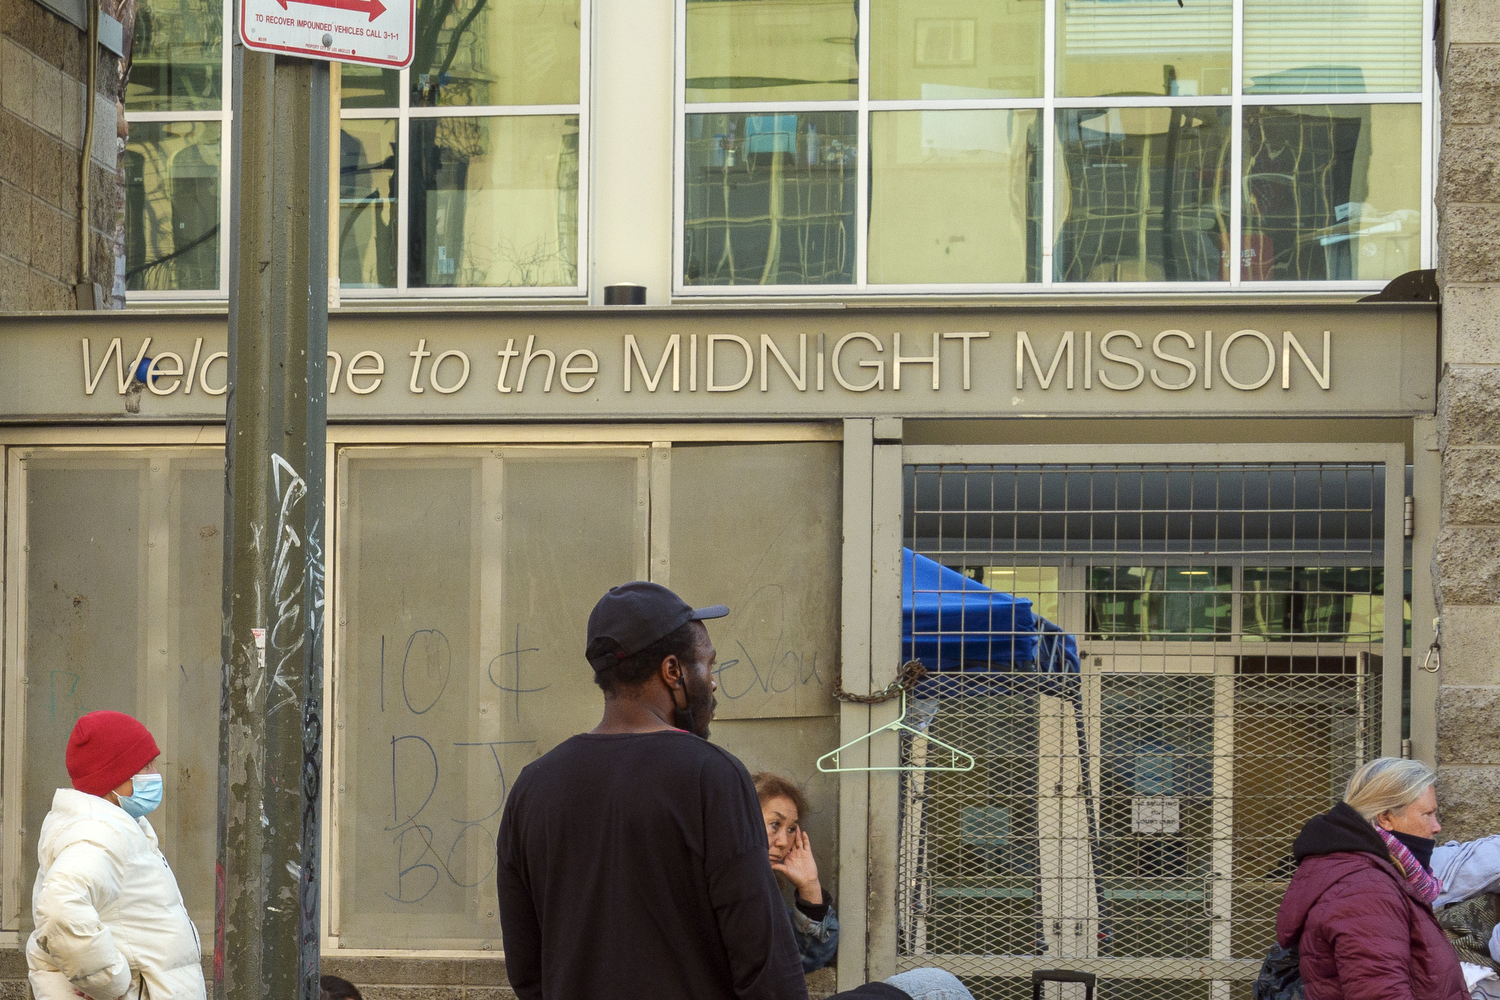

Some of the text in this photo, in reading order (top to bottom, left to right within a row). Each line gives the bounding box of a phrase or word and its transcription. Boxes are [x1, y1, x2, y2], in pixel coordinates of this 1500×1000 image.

[255, 13, 399, 41] TO RECOVER IMPOUNDED VEHICLES CALL 3-1-1
[409, 338, 470, 394] to
[497, 334, 599, 393] the
[622, 331, 991, 393] MIDNIGHT
[1015, 329, 1331, 391] MISSION
